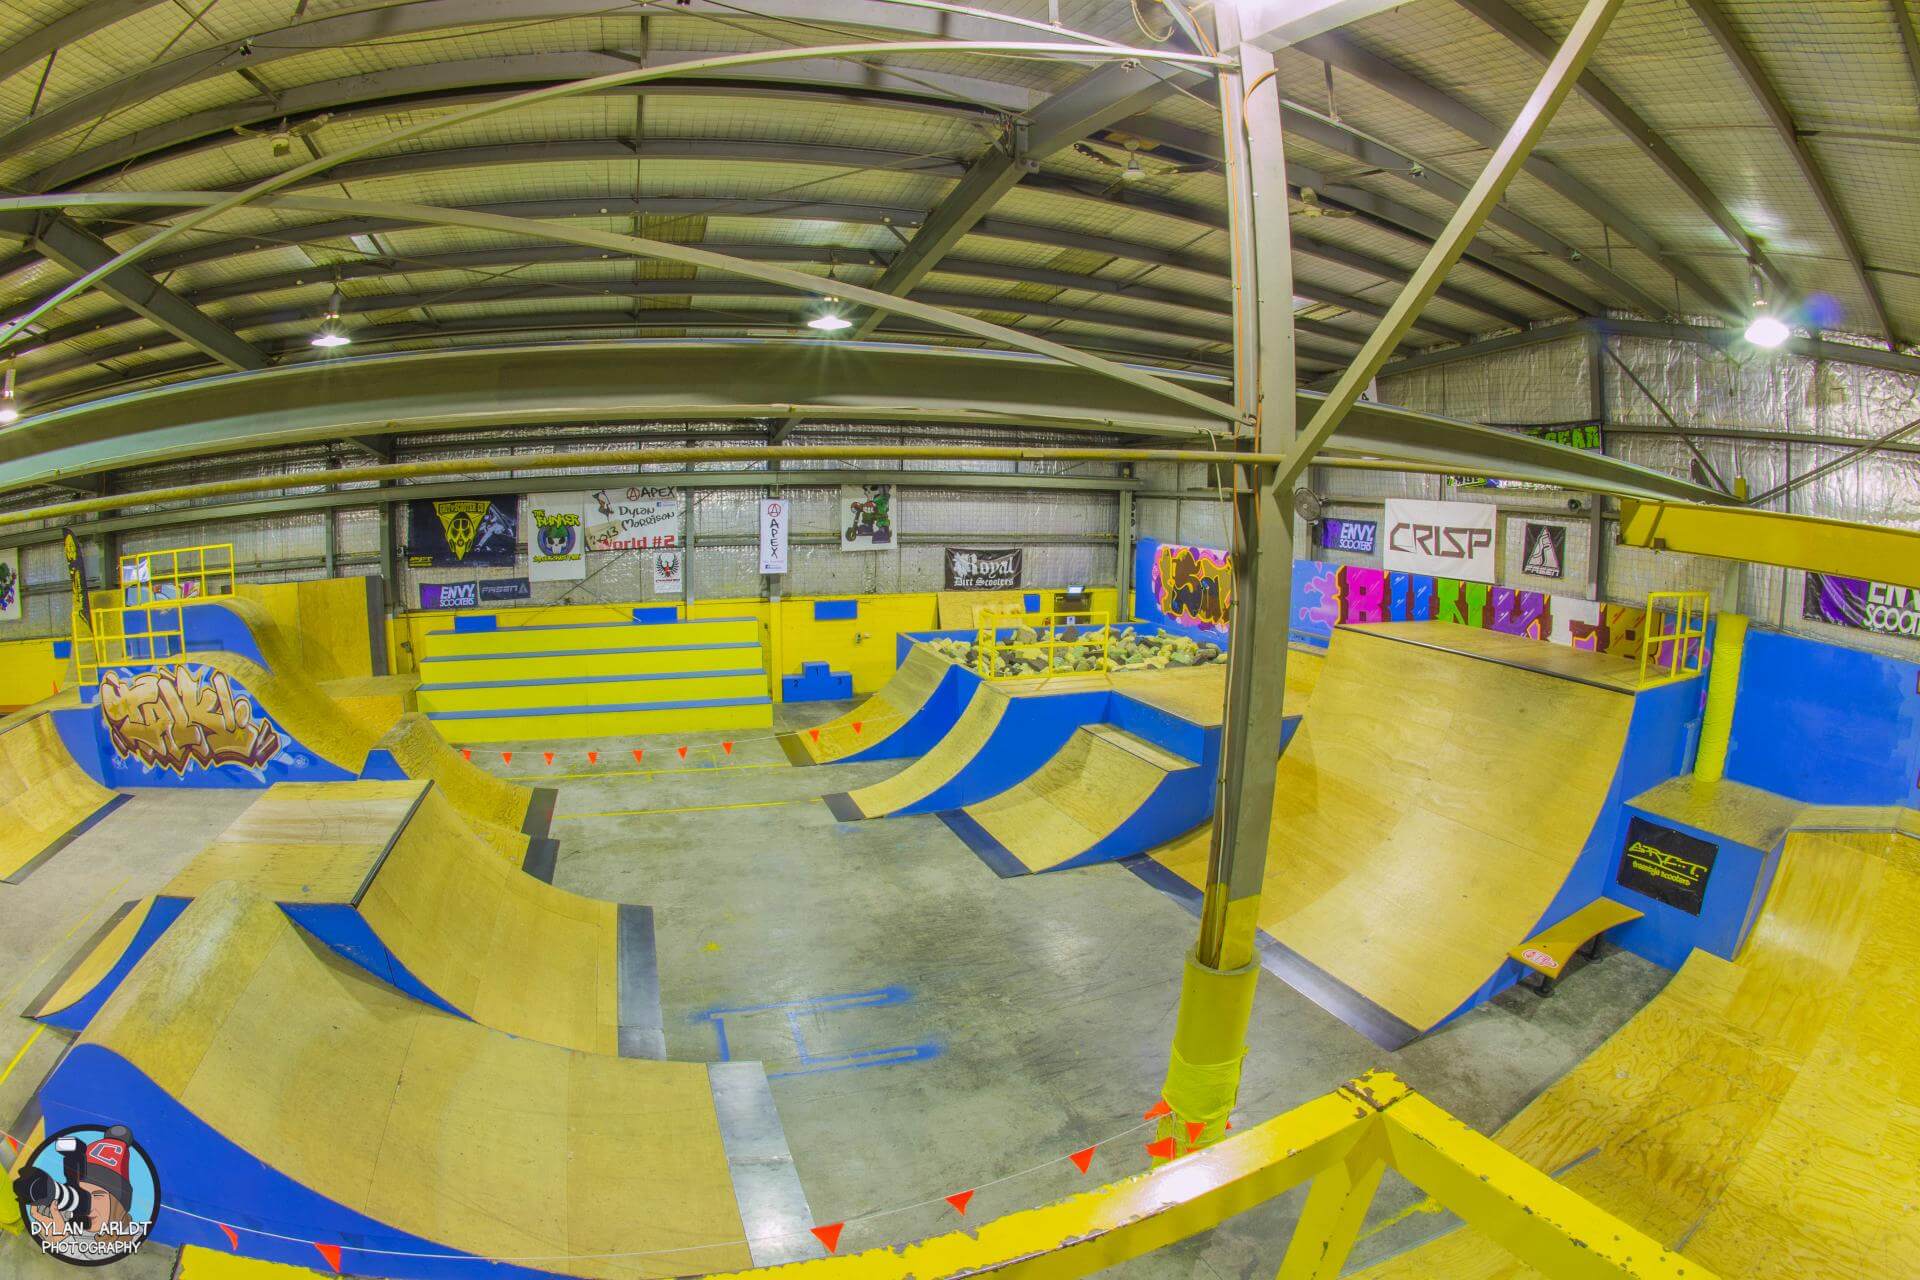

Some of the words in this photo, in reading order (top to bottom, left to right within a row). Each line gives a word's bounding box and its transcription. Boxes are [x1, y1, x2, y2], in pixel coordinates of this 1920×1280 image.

[641, 486, 675, 498] APEX
[770, 518, 780, 559] APEX
[1339, 539, 1373, 552] SCOOTERS
[1389, 522, 1492, 560] CRISP
[956, 553, 1015, 579] Royal
[954, 576, 974, 587] Dirt
[439, 598, 475, 607] SCOOTERS
[1867, 581, 1920, 611] EN
